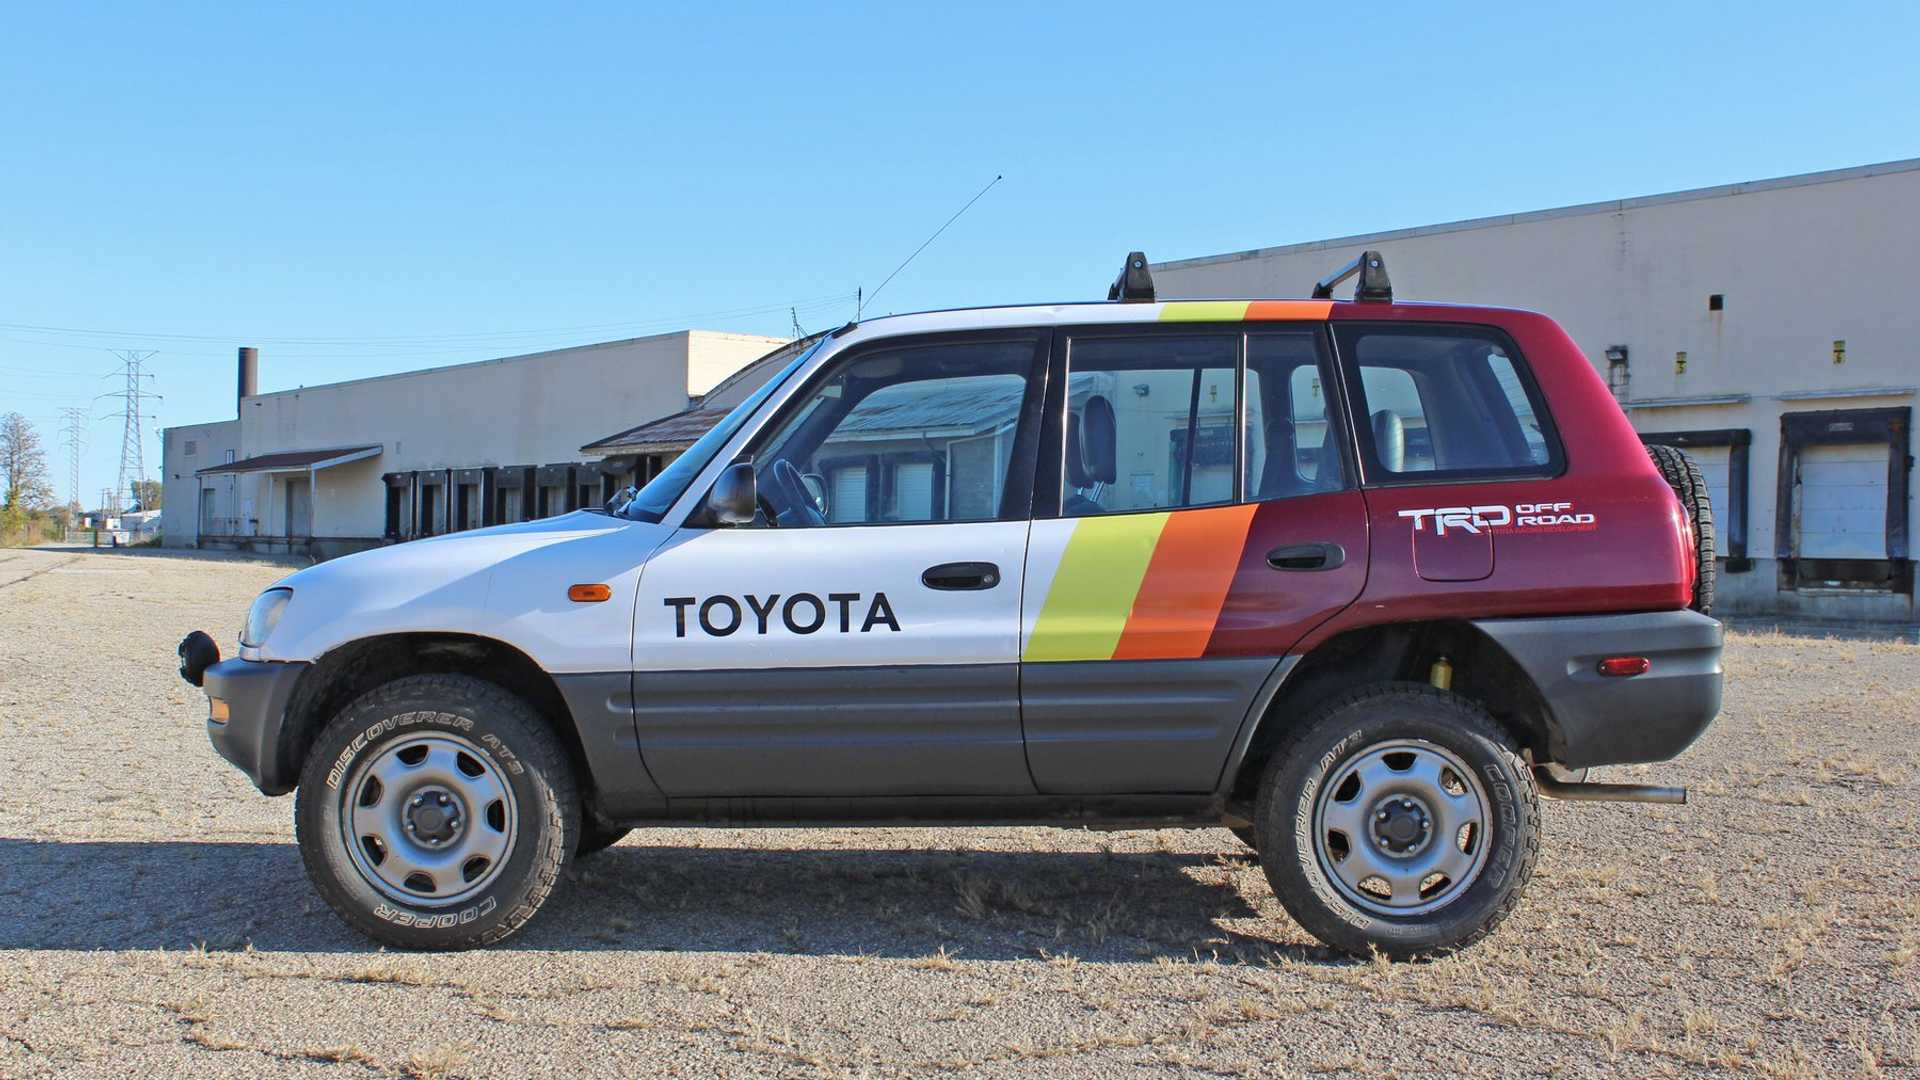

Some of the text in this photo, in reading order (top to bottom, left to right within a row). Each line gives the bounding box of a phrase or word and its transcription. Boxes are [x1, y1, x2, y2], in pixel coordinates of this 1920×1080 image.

[1398, 505, 1511, 536] TRD
[1515, 502, 1572, 514] OFF
[1517, 513, 1595, 526] ROAD
[663, 592, 902, 638] TOYOTA
[326, 710, 475, 792] DISCOVERER
[1483, 763, 1517, 890] COOPER
[373, 895, 497, 929] COOPER
